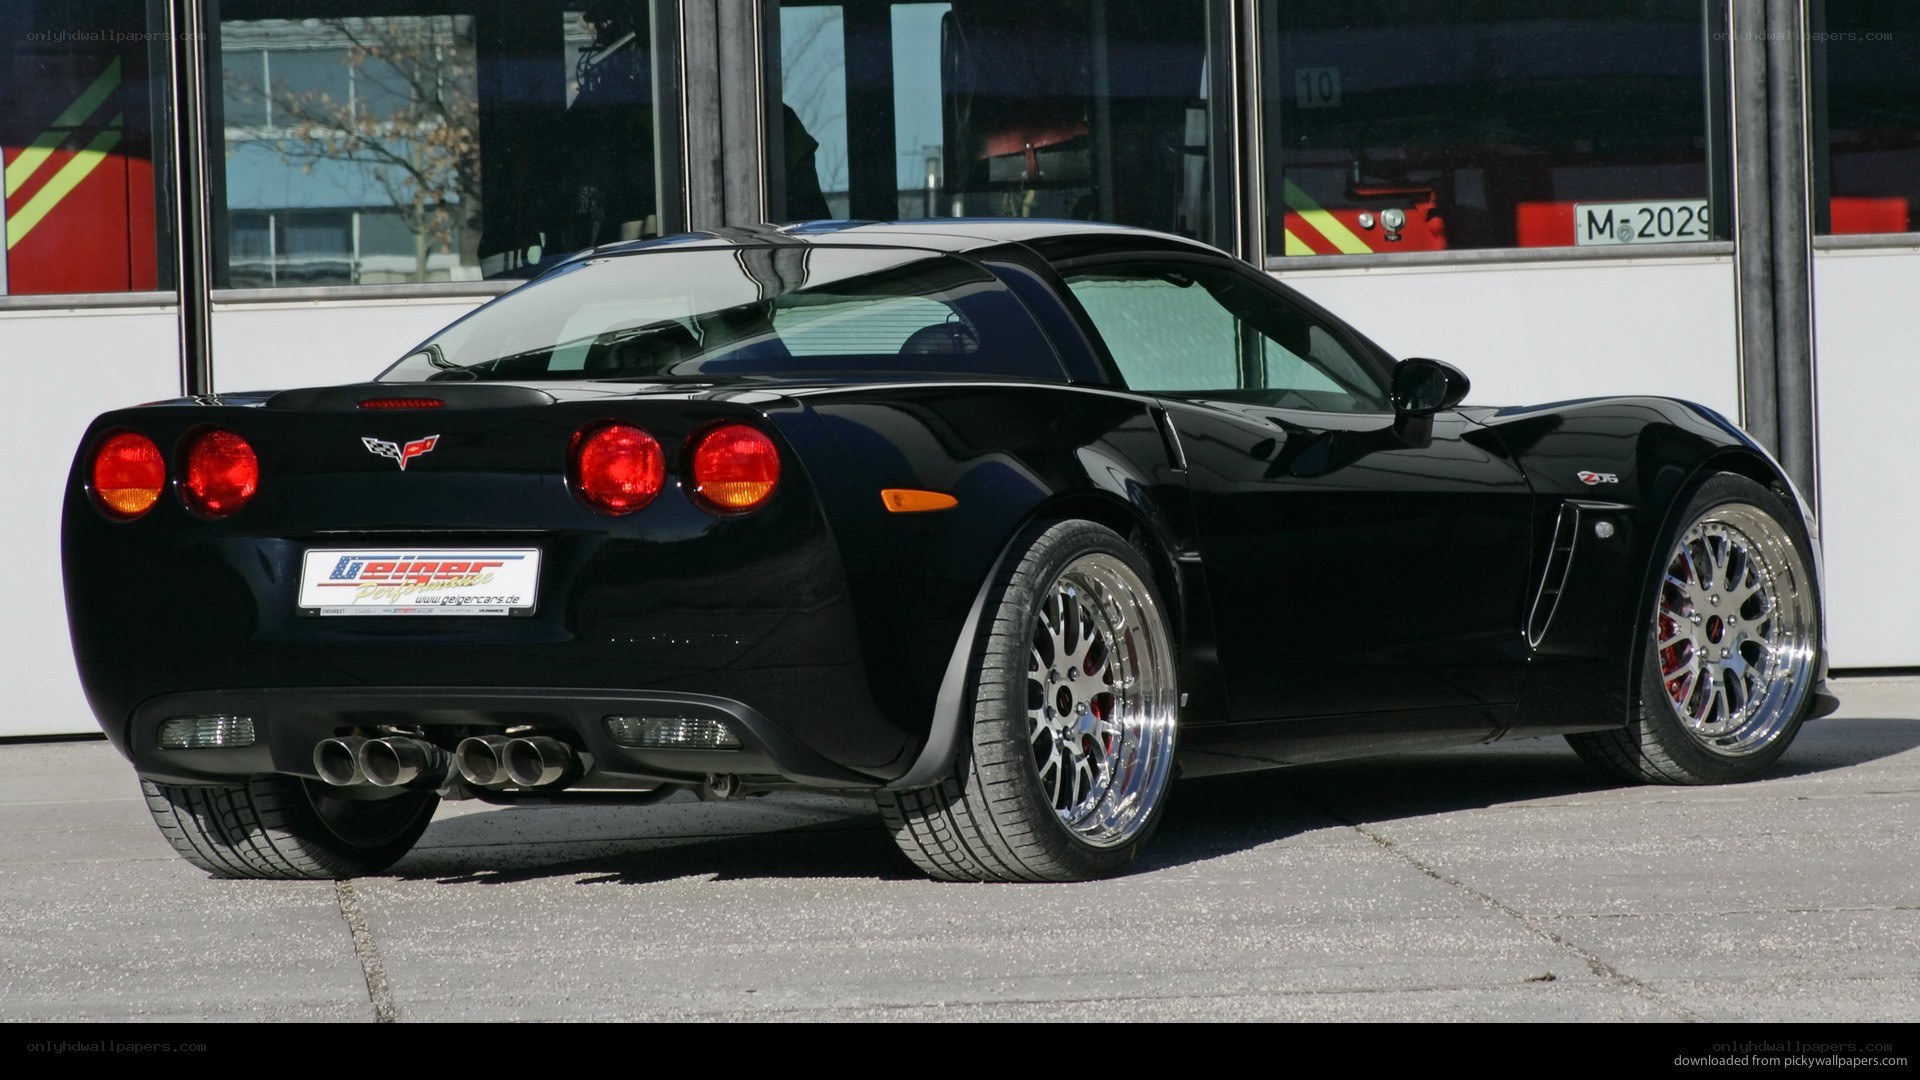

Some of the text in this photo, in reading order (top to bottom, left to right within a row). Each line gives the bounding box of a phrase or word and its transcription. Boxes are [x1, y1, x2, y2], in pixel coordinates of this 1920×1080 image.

[1301, 71, 1333, 102] 10
[1580, 472, 1619, 484] Z06
[329, 556, 503, 586] Geiger
[353, 572, 494, 604] Performance
[415, 595, 520, 606] www.geigercars.de
